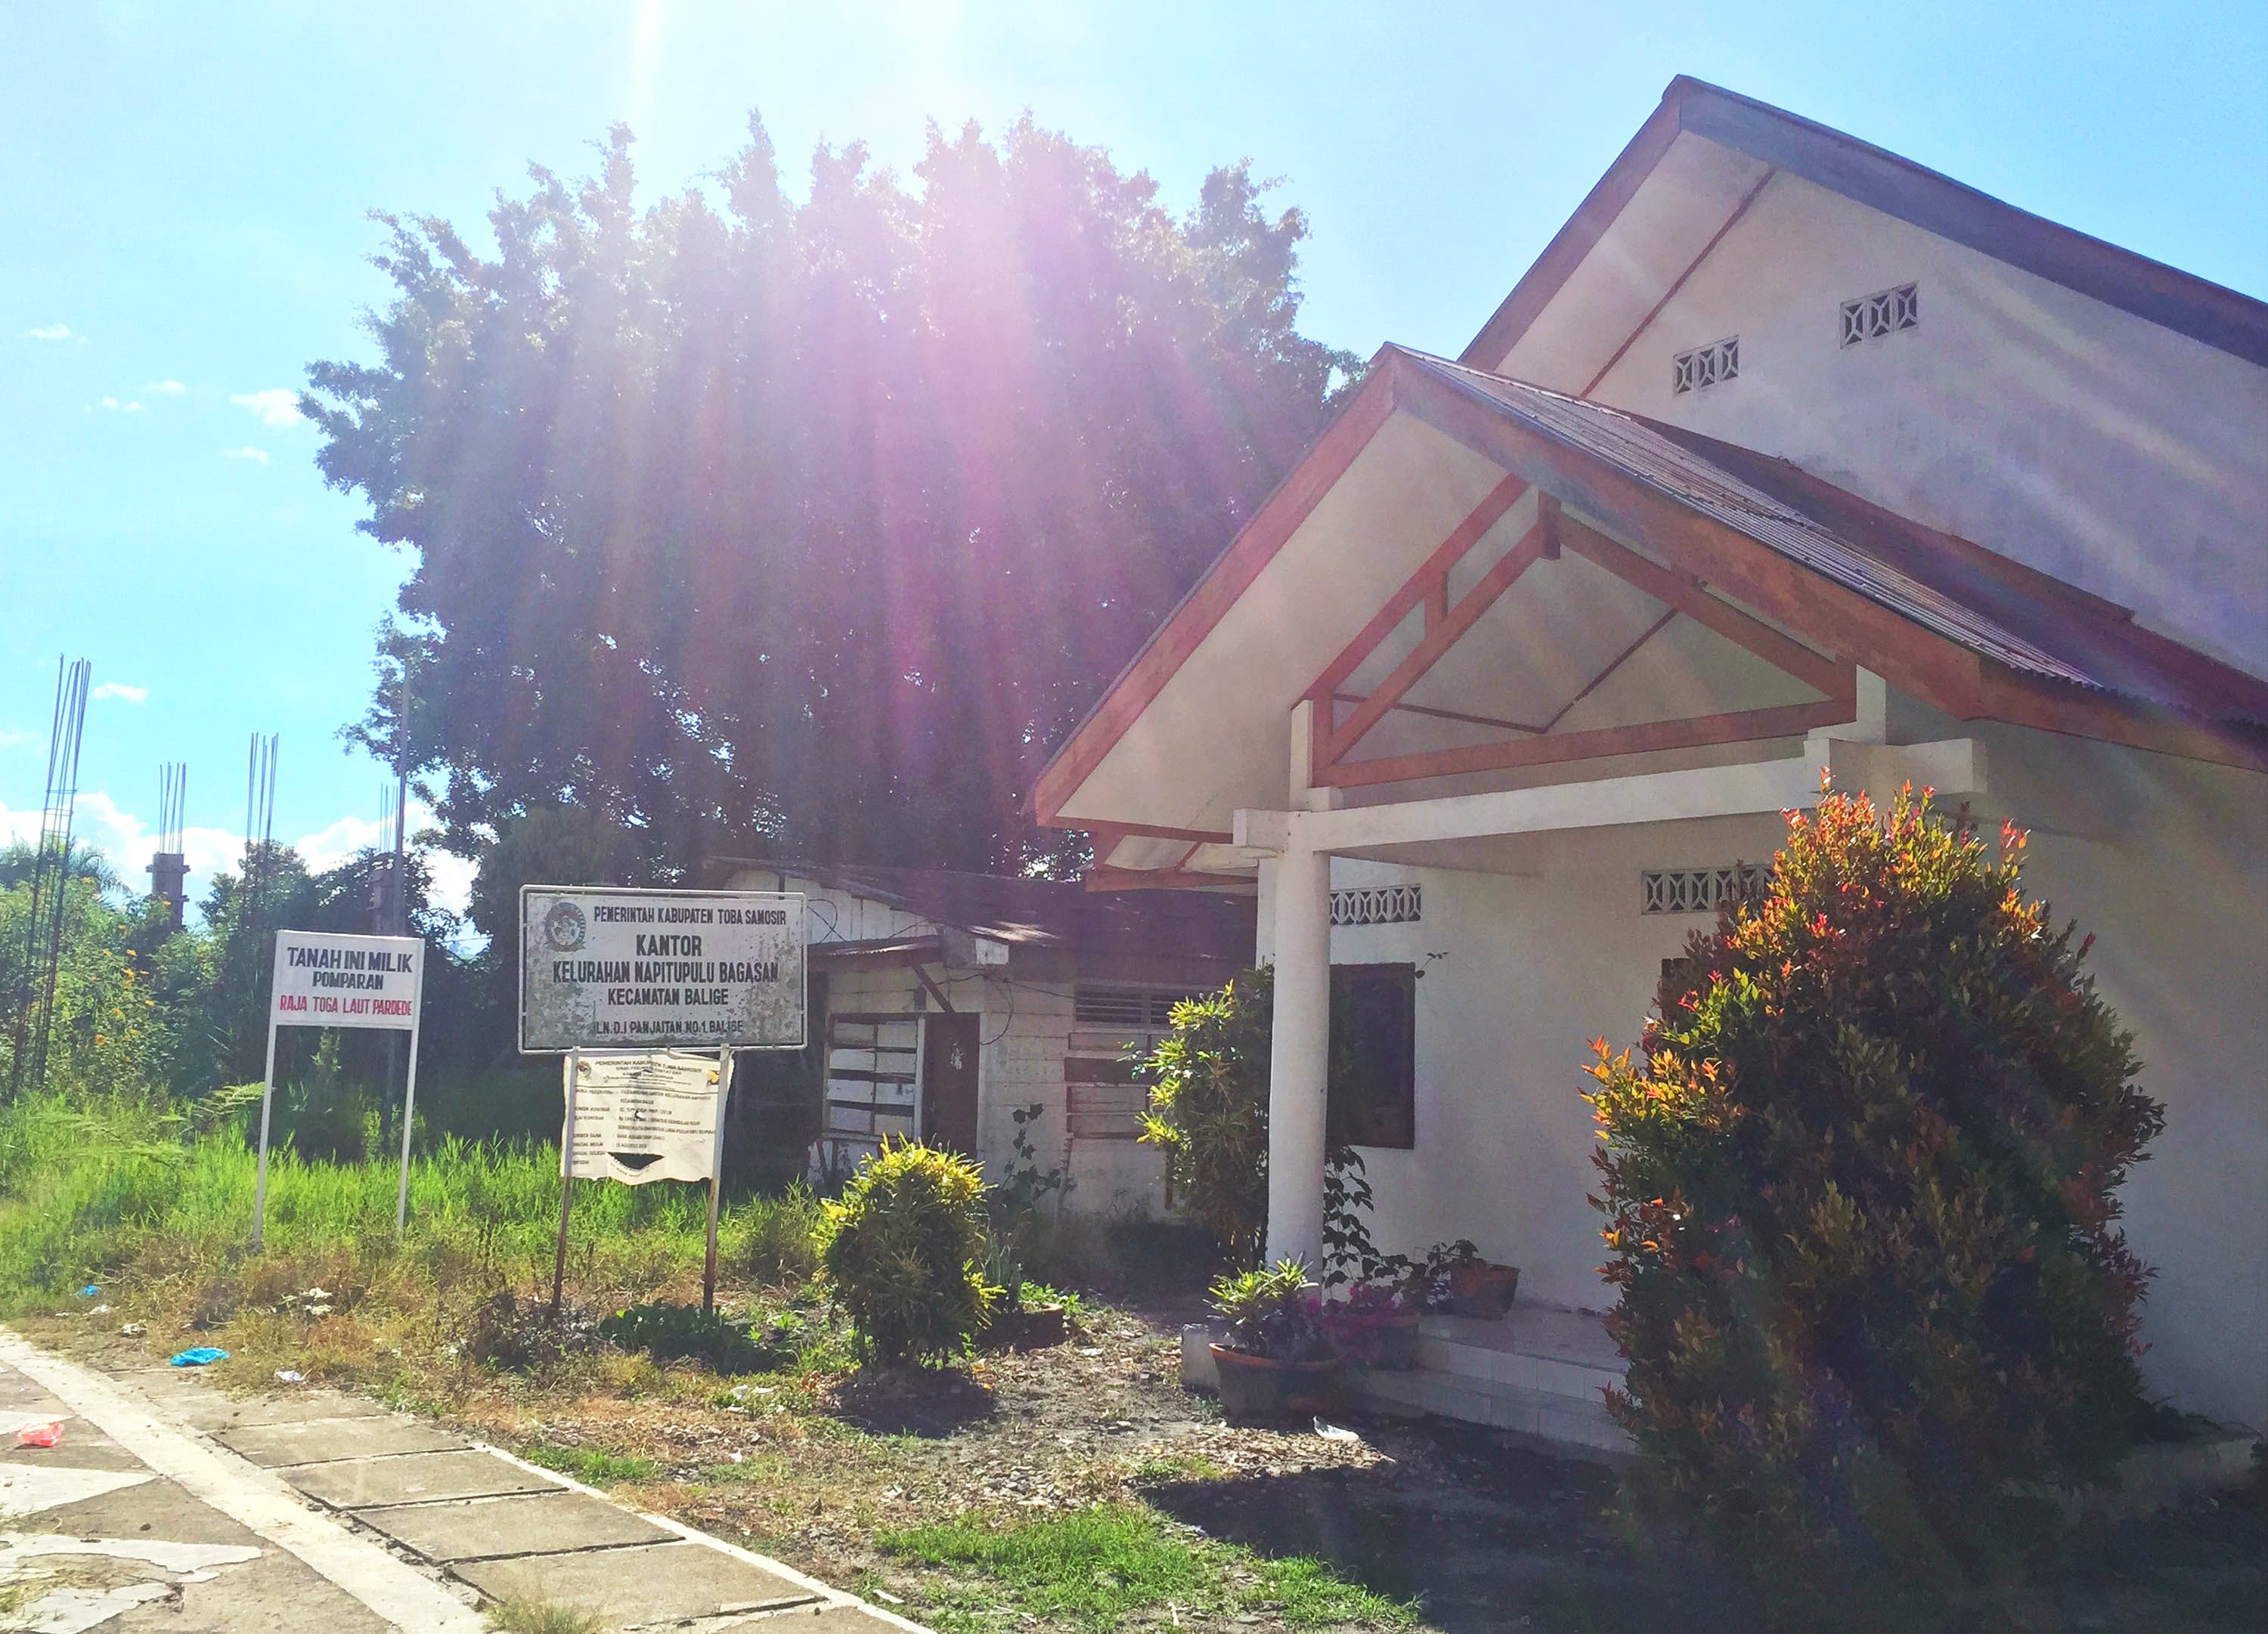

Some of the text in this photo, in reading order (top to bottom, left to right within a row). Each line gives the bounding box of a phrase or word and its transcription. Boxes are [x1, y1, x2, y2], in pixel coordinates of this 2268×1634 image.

[594, 906, 786, 926] PEMERINTAH KABUPATEN TOBA SAMOSIR
[636, 934, 702, 957] KANTOR
[287, 946, 413, 973] TANAH INI MILIK
[312, 971, 384, 990] POMPARAN
[553, 961, 778, 983] KELURAHAN NAPITUPULU BAGASAN
[280, 995, 412, 1016] RAJA TOGA LAUT PARDEDE
[608, 988, 729, 1005] KECAMATAN BALIGE
[630, 1020, 682, 1034] PANJAITAN
[709, 1020, 743, 1032] BALIGE
